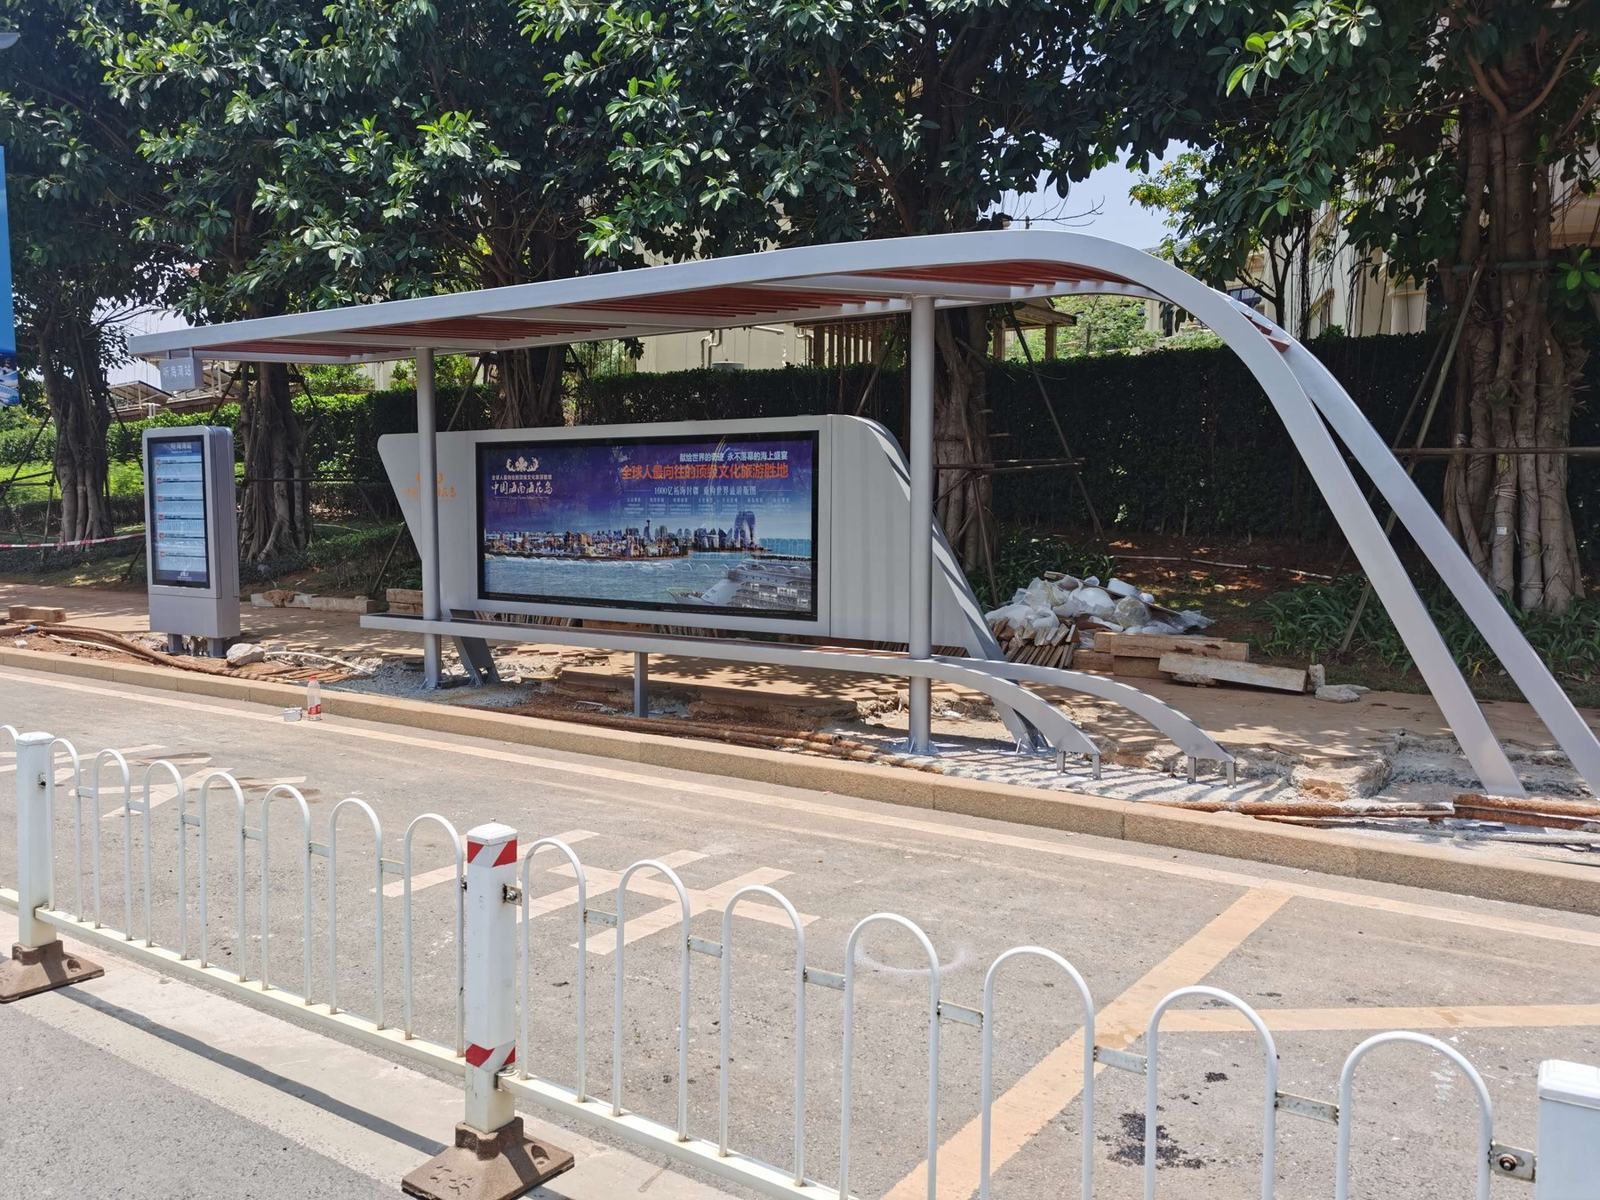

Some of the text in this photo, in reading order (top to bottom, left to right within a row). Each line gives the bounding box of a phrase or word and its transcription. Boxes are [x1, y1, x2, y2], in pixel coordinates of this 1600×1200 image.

[621, 463, 789, 481] 全球人最向往的顶级文化旅游胜地
